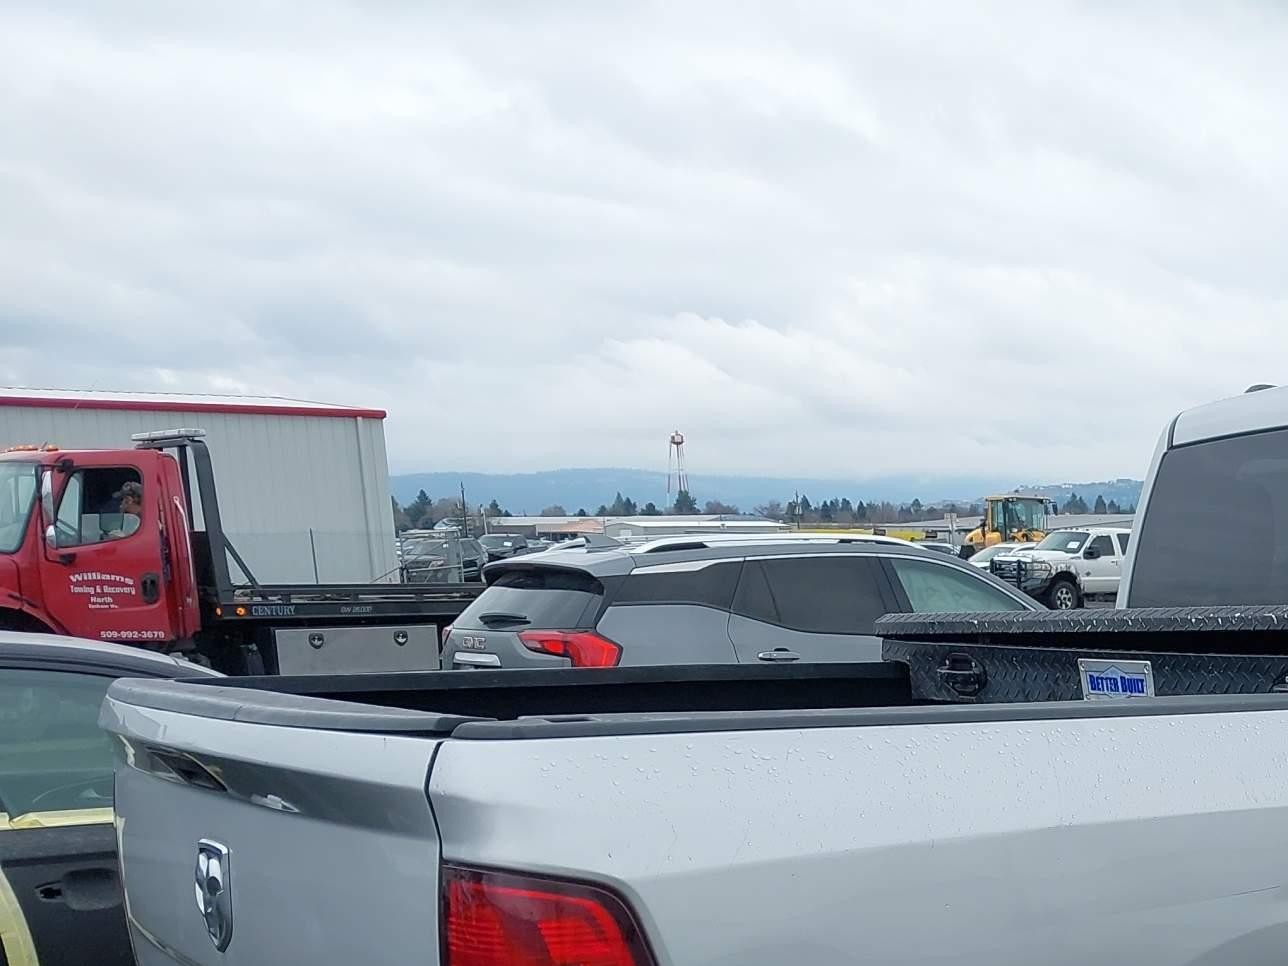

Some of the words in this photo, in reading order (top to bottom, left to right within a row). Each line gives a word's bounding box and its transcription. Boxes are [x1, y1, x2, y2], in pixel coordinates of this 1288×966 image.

[69, 572, 134, 585] Williams
[70, 585, 94, 594] Towing
[96, 585, 102, 593] &
[103, 585, 136, 595] Recovery
[252, 605, 296, 616] CENTURY
[1088, 674, 1120, 693] BETTER
[1120, 675, 1145, 694] BUILT
